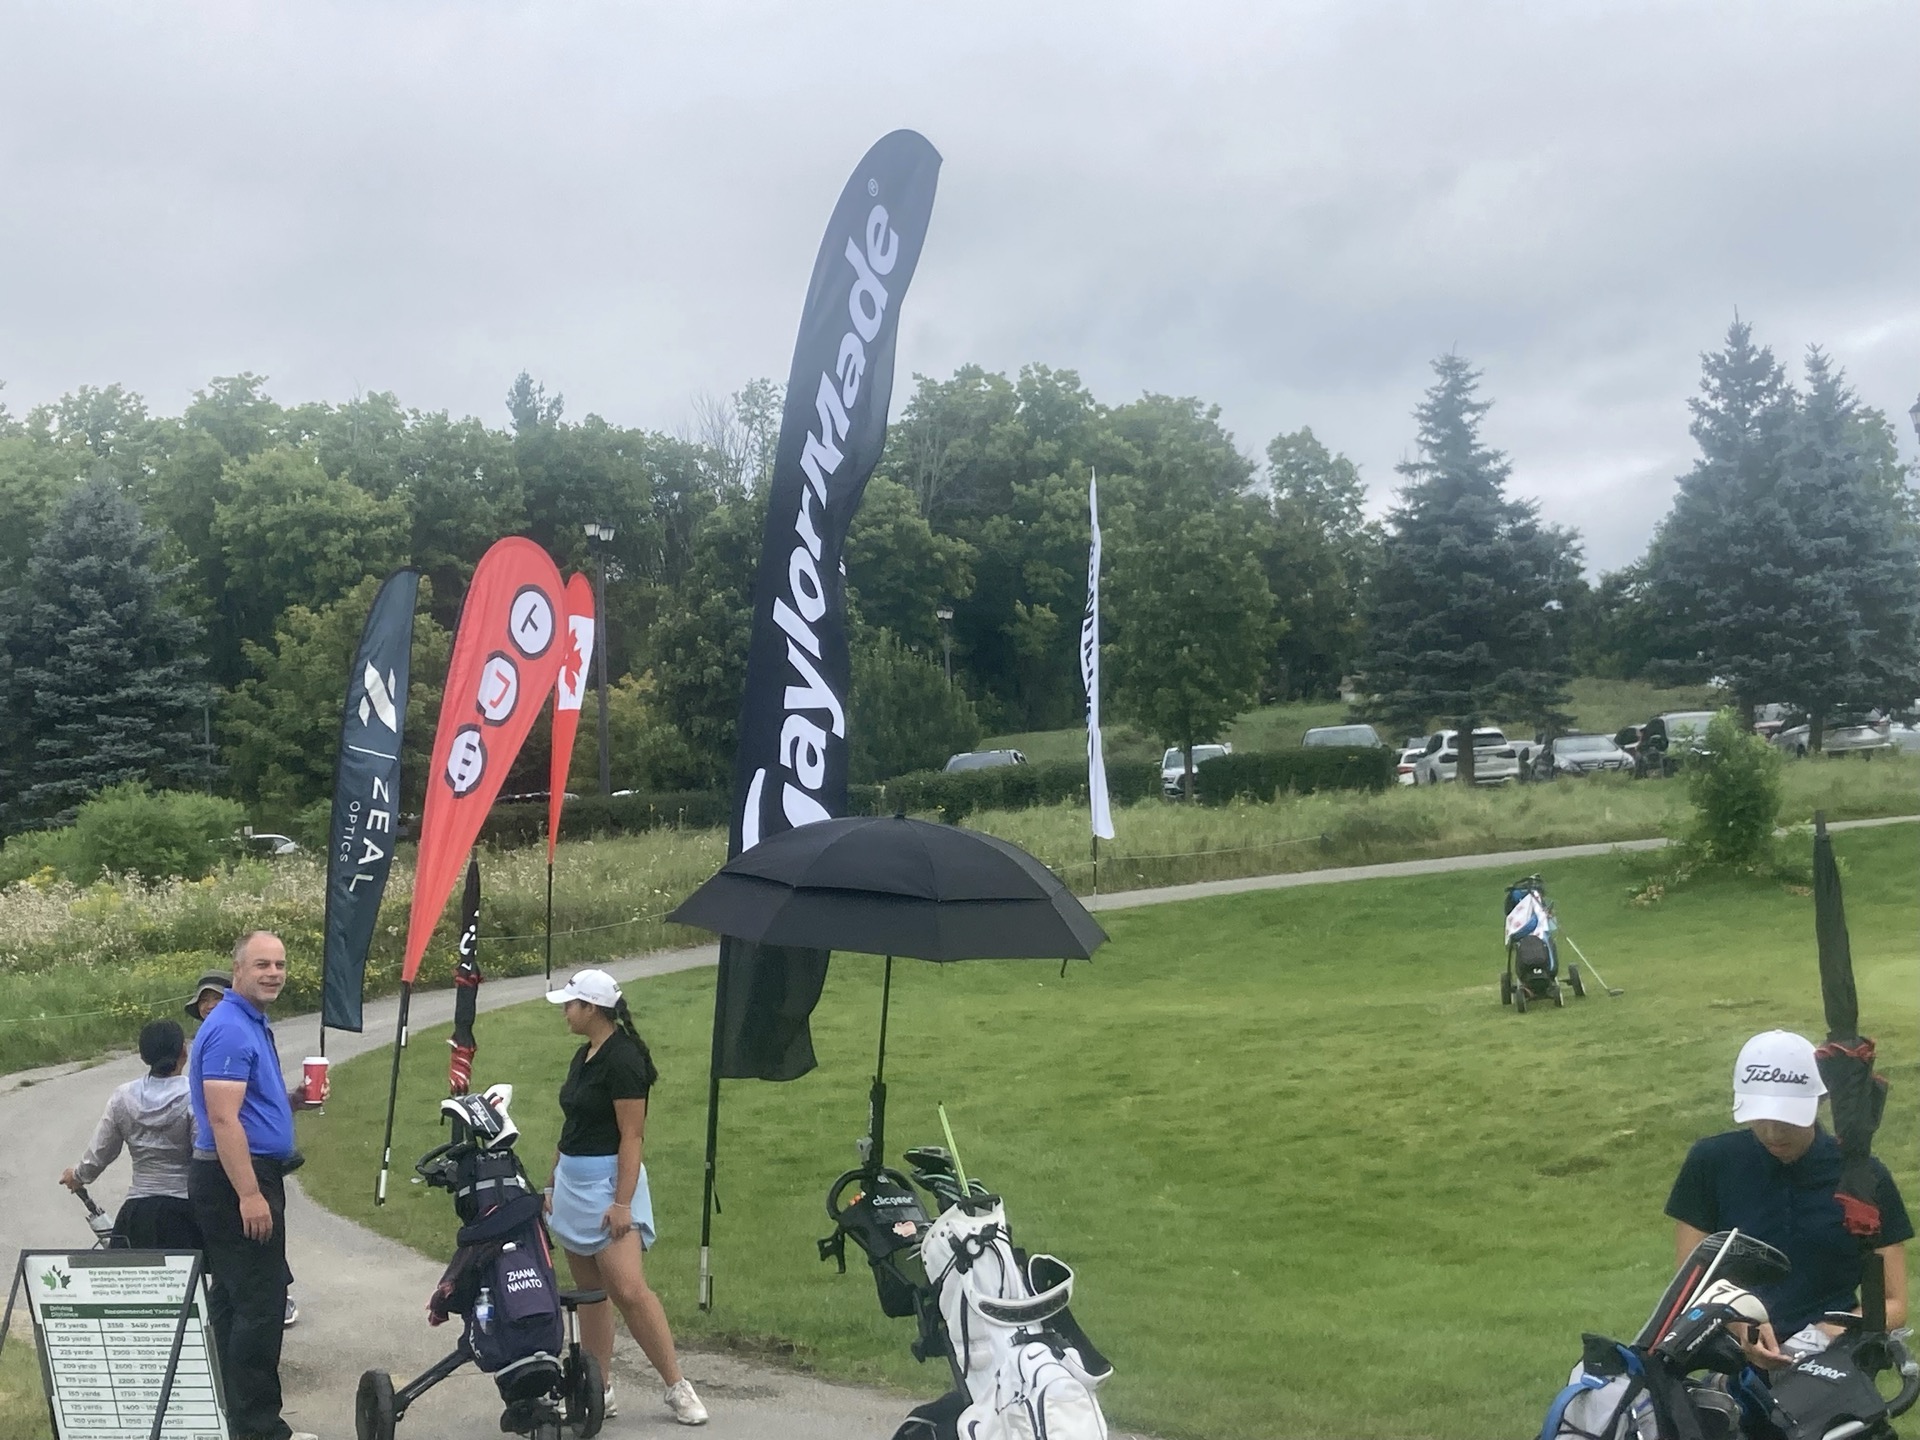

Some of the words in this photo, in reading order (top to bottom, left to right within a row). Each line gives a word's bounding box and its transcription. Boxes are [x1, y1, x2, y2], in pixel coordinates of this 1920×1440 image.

[339, 800, 361, 863] OPTICS
[348, 776, 391, 893] ZEAL
[1741, 1064, 1810, 1084] Titleist
[872, 1195, 914, 1207] clicgear
[507, 1268, 537, 1281] ZHANA
[507, 1278, 543, 1293] NAVATO
